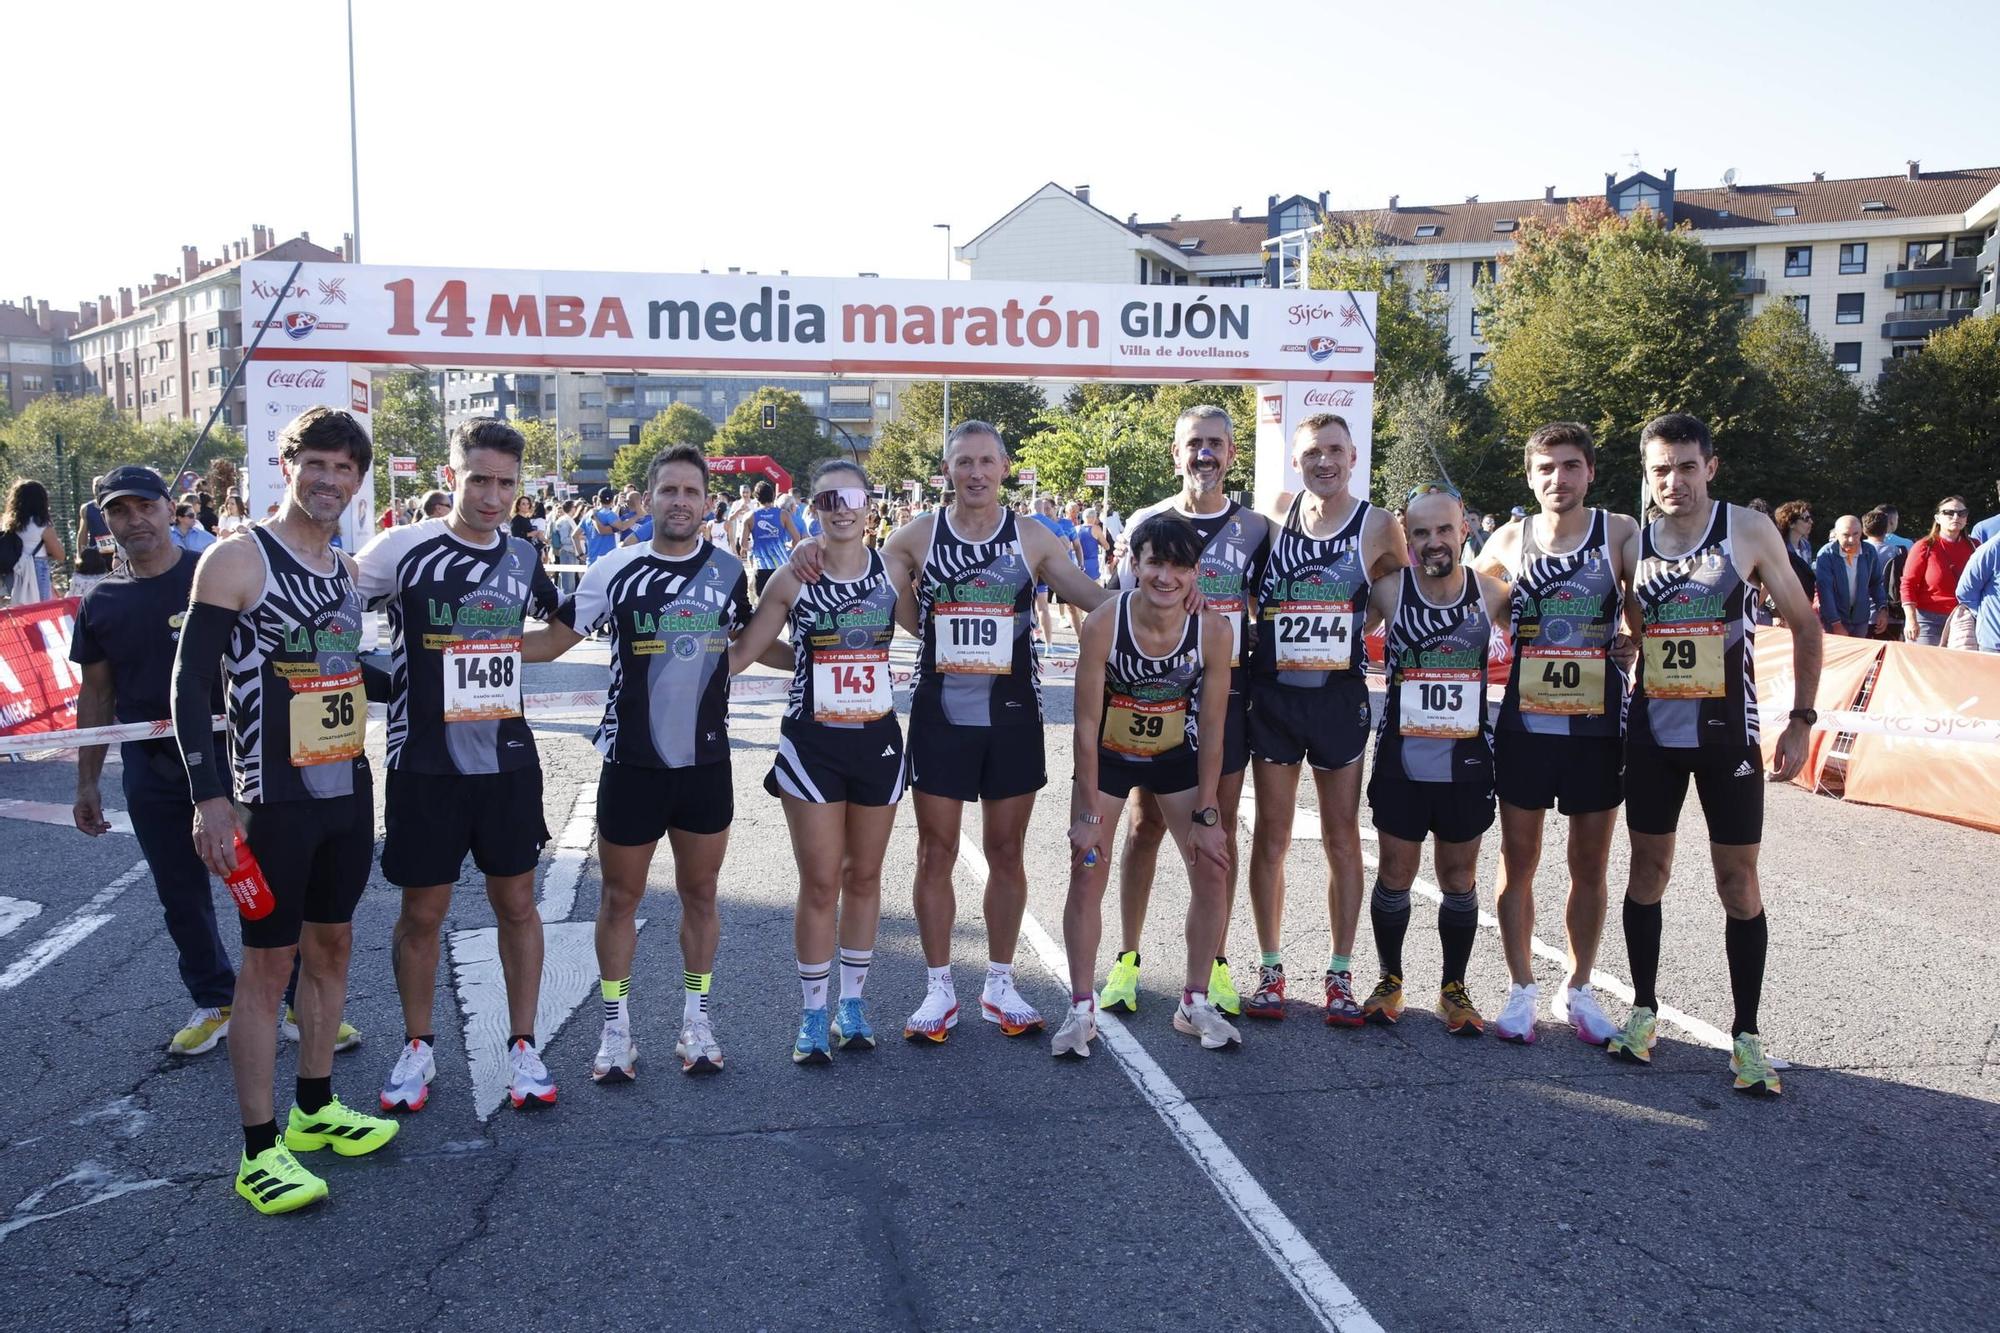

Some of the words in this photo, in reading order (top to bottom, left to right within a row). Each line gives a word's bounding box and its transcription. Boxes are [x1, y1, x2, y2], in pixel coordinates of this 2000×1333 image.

[384, 278, 476, 338] 14
[486, 294, 634, 338] MBA
[649, 286, 825, 343] media
[842, 294, 1099, 348] maratón
[1121, 295, 1249, 340] GIJÓN
[1120, 344, 1152, 357] Villa
[1156, 345, 1172, 357] de
[1176, 346, 1249, 359] Jovellanos
[954, 567, 1005, 583] RESTAURANTE
[1293, 564, 1341, 581] RESTAURANTE
[459, 590, 512, 605] RESTAURANTE
[954, 581, 1017, 606] CEREZAL
[1291, 580, 1351, 602] CEREZAL
[1540, 579, 1590, 597] RESTAURANTE
[1657, 582, 1711, 602] RESTAURANTE
[429, 598, 453, 625] LA
[457, 604, 521, 628] CEREZAL
[659, 599, 709, 614] RESTAURANTE
[836, 599, 877, 612] RESTAURANTE
[1540, 594, 1604, 617] CEREZAL
[1658, 592, 1727, 622] CEREZAL
[314, 610, 357, 628] RESTAURANTE
[633, 610, 656, 633] LA
[659, 610, 720, 632] CEREZAL
[815, 611, 834, 630] LA
[836, 607, 890, 628] CEREZAL
[1279, 615, 1347, 643] 2244
[283, 623, 312, 653] LA
[950, 618, 997, 647] 1119
[1420, 635, 1472, 650] RESTAURANTE
[1420, 648, 1481, 669] CEREZAL
[1662, 640, 1696, 669] 29
[454, 656, 514, 689] 1488
[831, 665, 875, 694] 143
[1542, 661, 1580, 688] 40
[1419, 683, 1463, 711] 103
[321, 692, 354, 729] 36
[1129, 713, 1164, 737] 39
[1734, 768, 1755, 777] adidas
